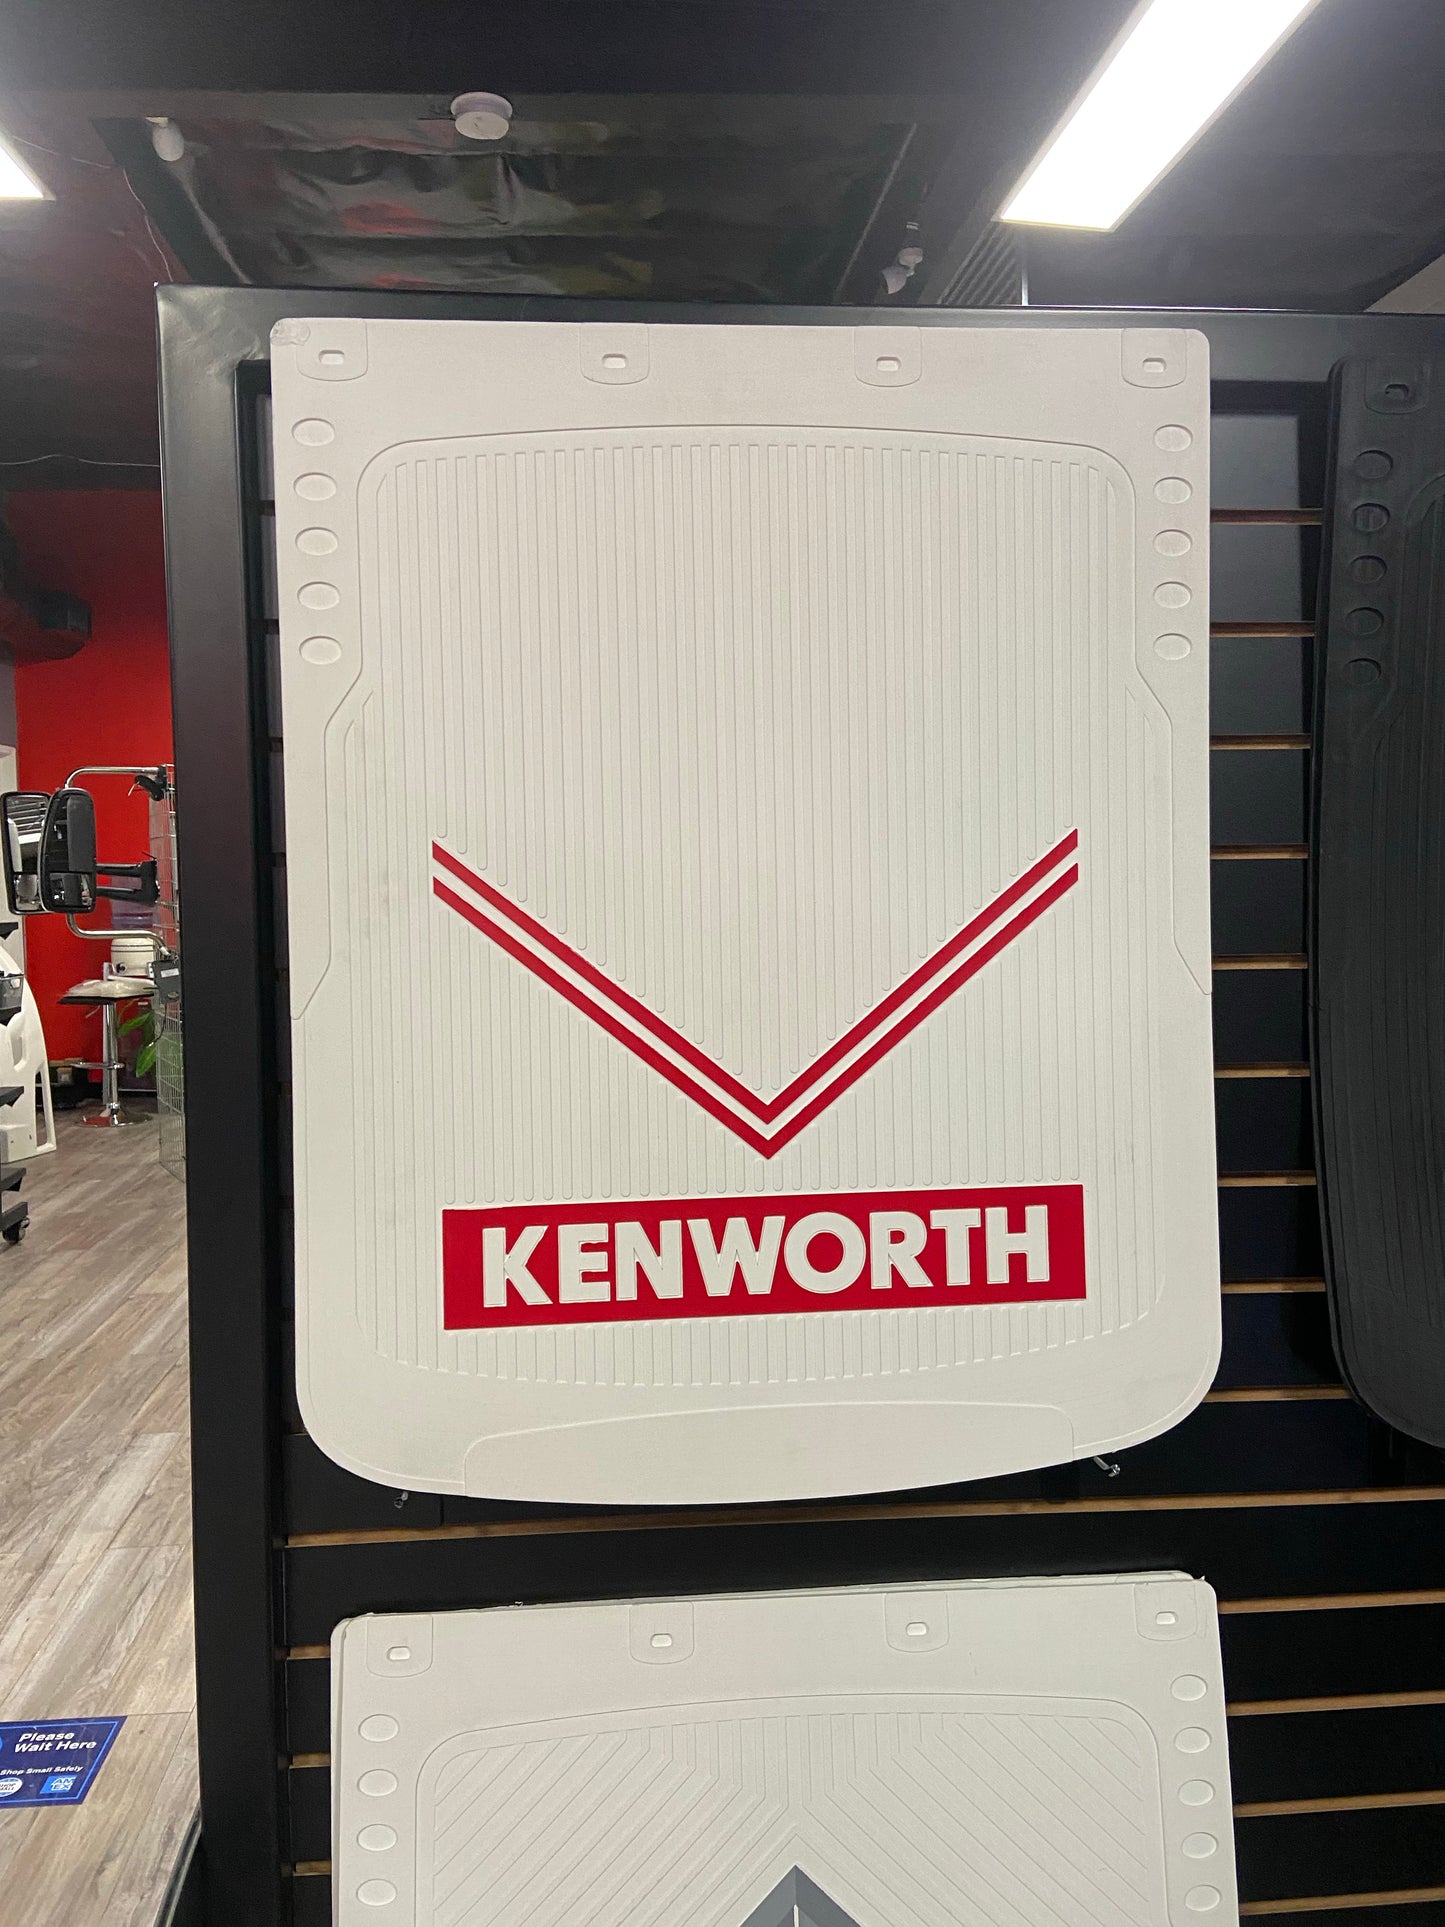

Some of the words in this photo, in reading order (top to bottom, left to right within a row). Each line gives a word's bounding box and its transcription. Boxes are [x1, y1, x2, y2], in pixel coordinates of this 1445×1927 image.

[482, 1205, 1049, 1308] KENWORTH
[19, 1732, 75, 1742] Please
[15, 1743, 52, 1753] Wait
[56, 1741, 97, 1751] Here
